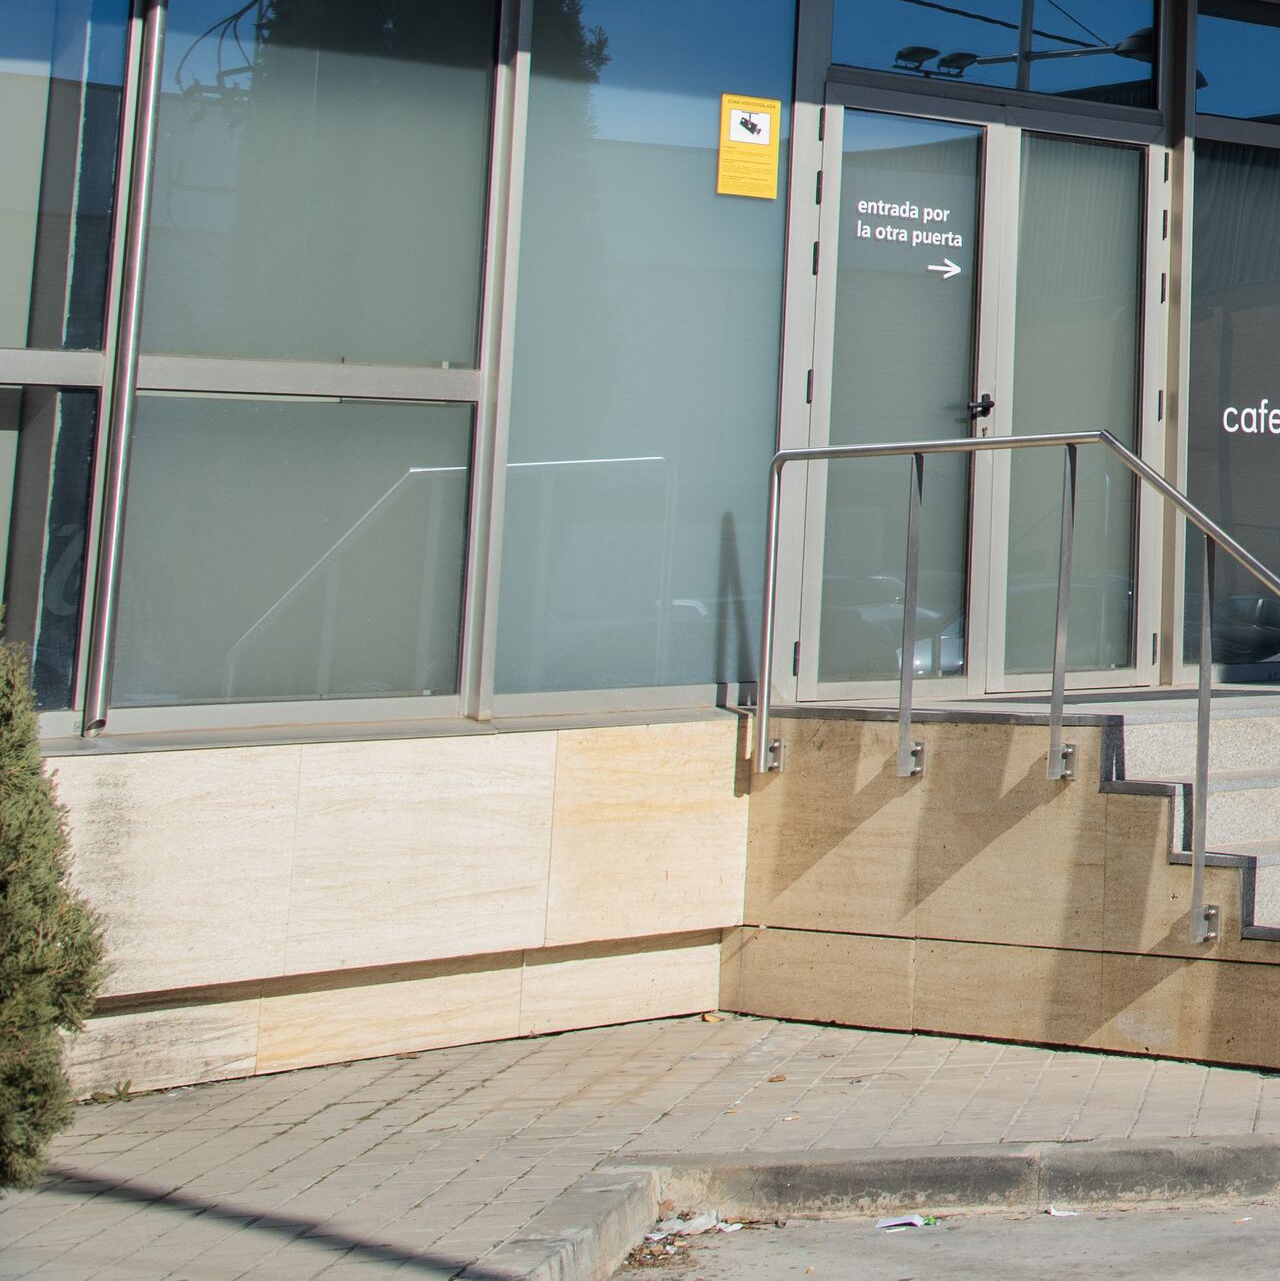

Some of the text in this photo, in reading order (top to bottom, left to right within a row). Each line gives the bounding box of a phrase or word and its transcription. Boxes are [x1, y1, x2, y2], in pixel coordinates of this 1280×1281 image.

[857, 198, 951, 224] entrada por
[856, 219, 963, 248] la otra puerta
